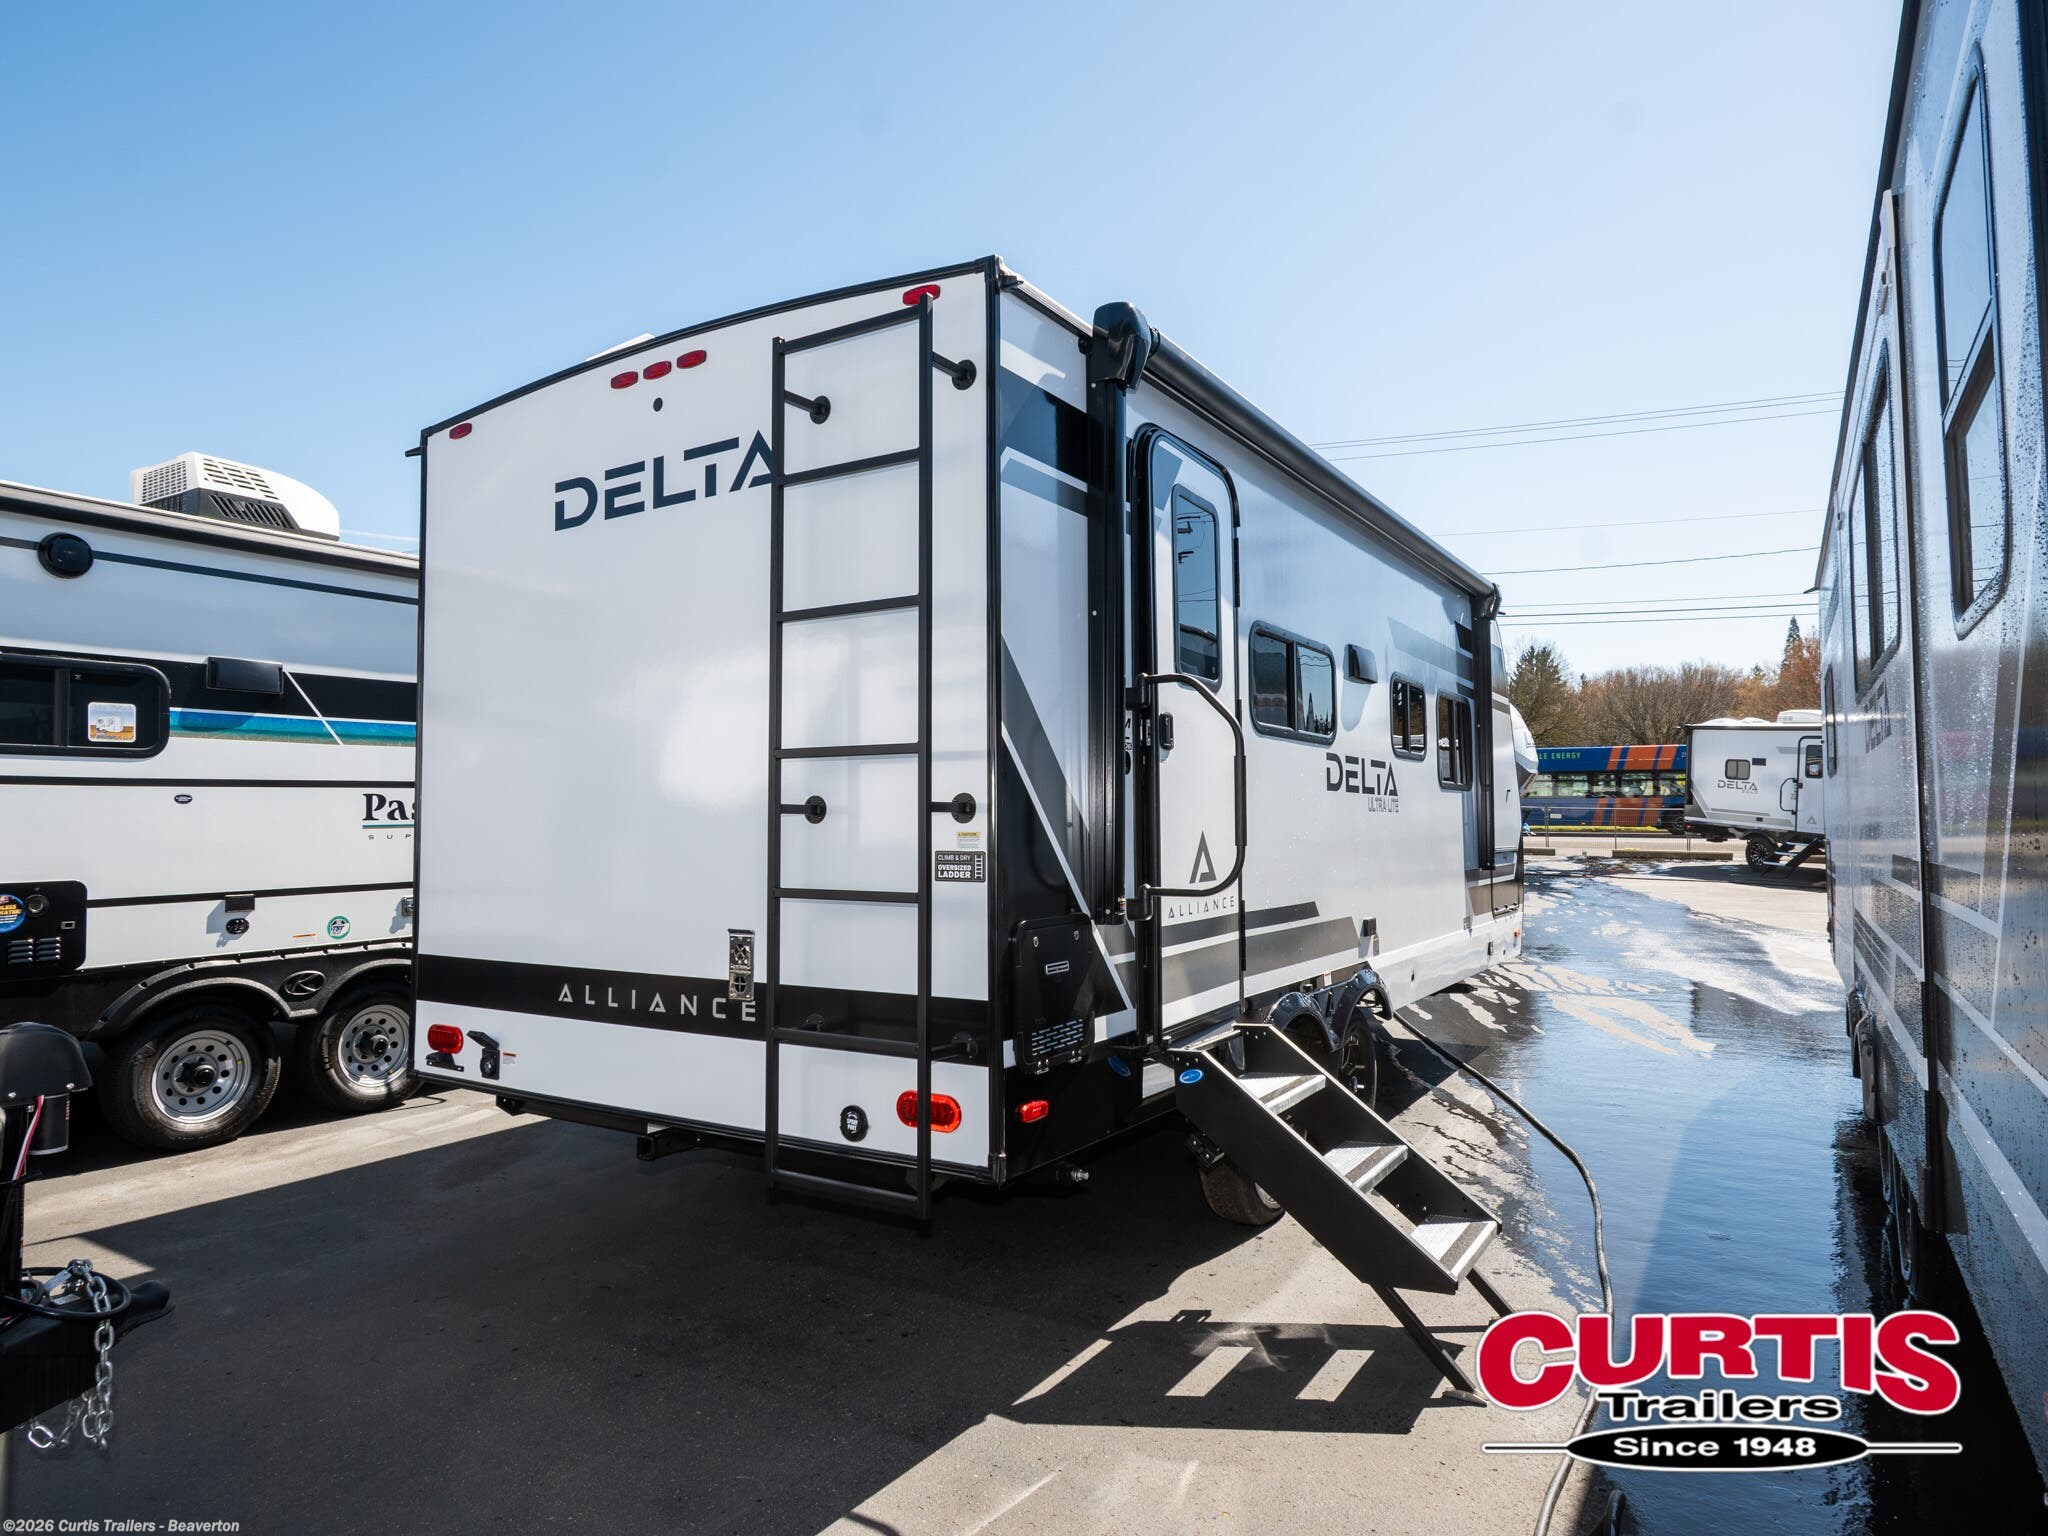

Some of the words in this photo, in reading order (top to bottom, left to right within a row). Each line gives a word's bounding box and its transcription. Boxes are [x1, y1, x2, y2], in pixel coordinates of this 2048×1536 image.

[554, 429, 772, 531] DELTA
[1551, 752, 1582, 760] ENERGY
[1326, 751, 1399, 796] DELTA
[1717, 780, 1758, 791] DELTA
[362, 793, 415, 820] Pa
[1368, 797, 1387, 812] ULTRA
[1388, 798, 1400, 813] LITE
[937, 871, 971, 879] LADDER
[1167, 895, 1235, 919] ALLIANCE
[558, 983, 757, 1022] ALLIANCE
